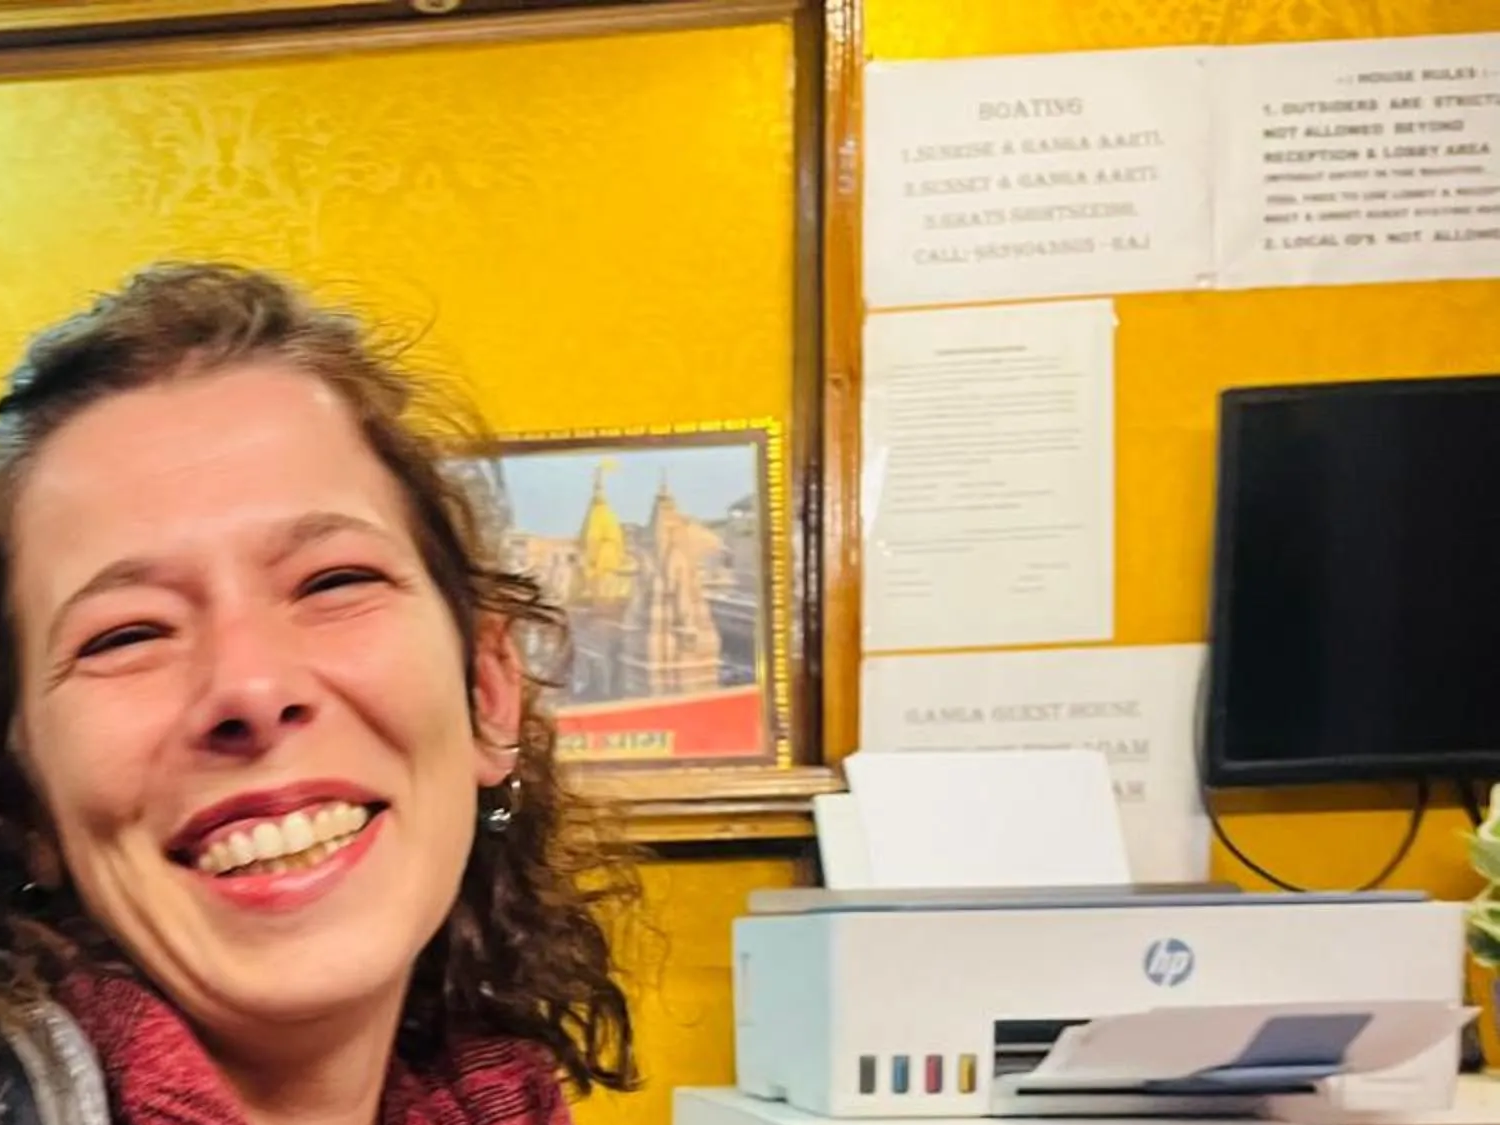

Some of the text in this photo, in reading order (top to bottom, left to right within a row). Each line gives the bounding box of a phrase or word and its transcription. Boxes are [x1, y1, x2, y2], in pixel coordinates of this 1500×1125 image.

[1358, 70, 1414, 83] HOUSE
[1422, 68, 1476, 81] RULES
[978, 97, 1085, 120] BOATING
[1282, 99, 1378, 114] OUTSIDERS
[1390, 97, 1421, 109] ARE
[1263, 119, 1464, 139] NOT ALLOWED BEYOND
[1264, 142, 1490, 163] RECEPTION & LOBBY AREA
[1283, 235, 1339, 249] LOCAL
[1386, 230, 1422, 243] NOT
[1149, 938, 1190, 987] hp
